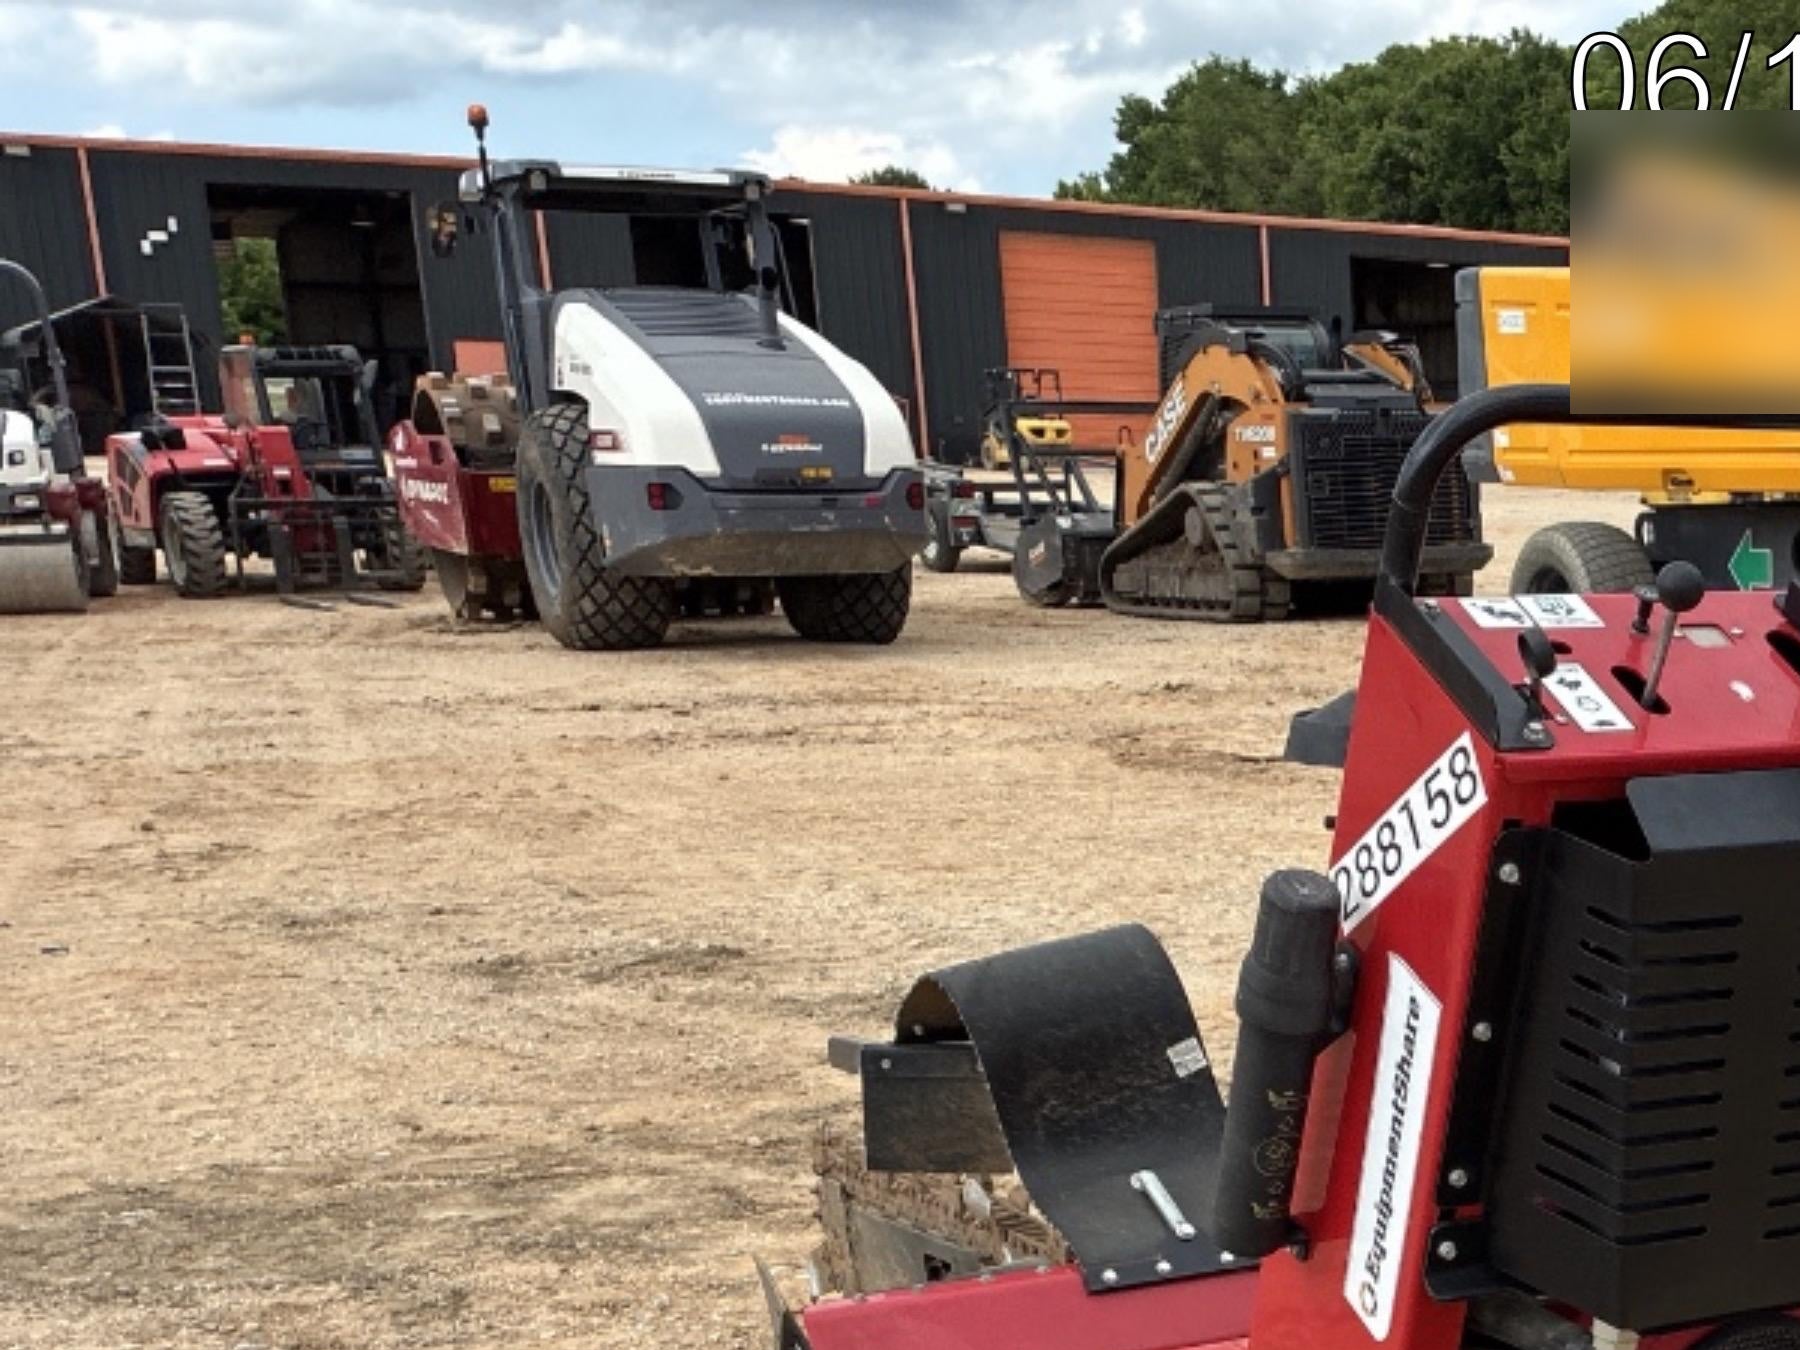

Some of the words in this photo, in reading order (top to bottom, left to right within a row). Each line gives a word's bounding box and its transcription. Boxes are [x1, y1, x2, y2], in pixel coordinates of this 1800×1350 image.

[1146, 380, 1184, 463] CASE
[1335, 746, 1477, 921] 288158
[1363, 994, 1420, 1284] EquipmentShare
